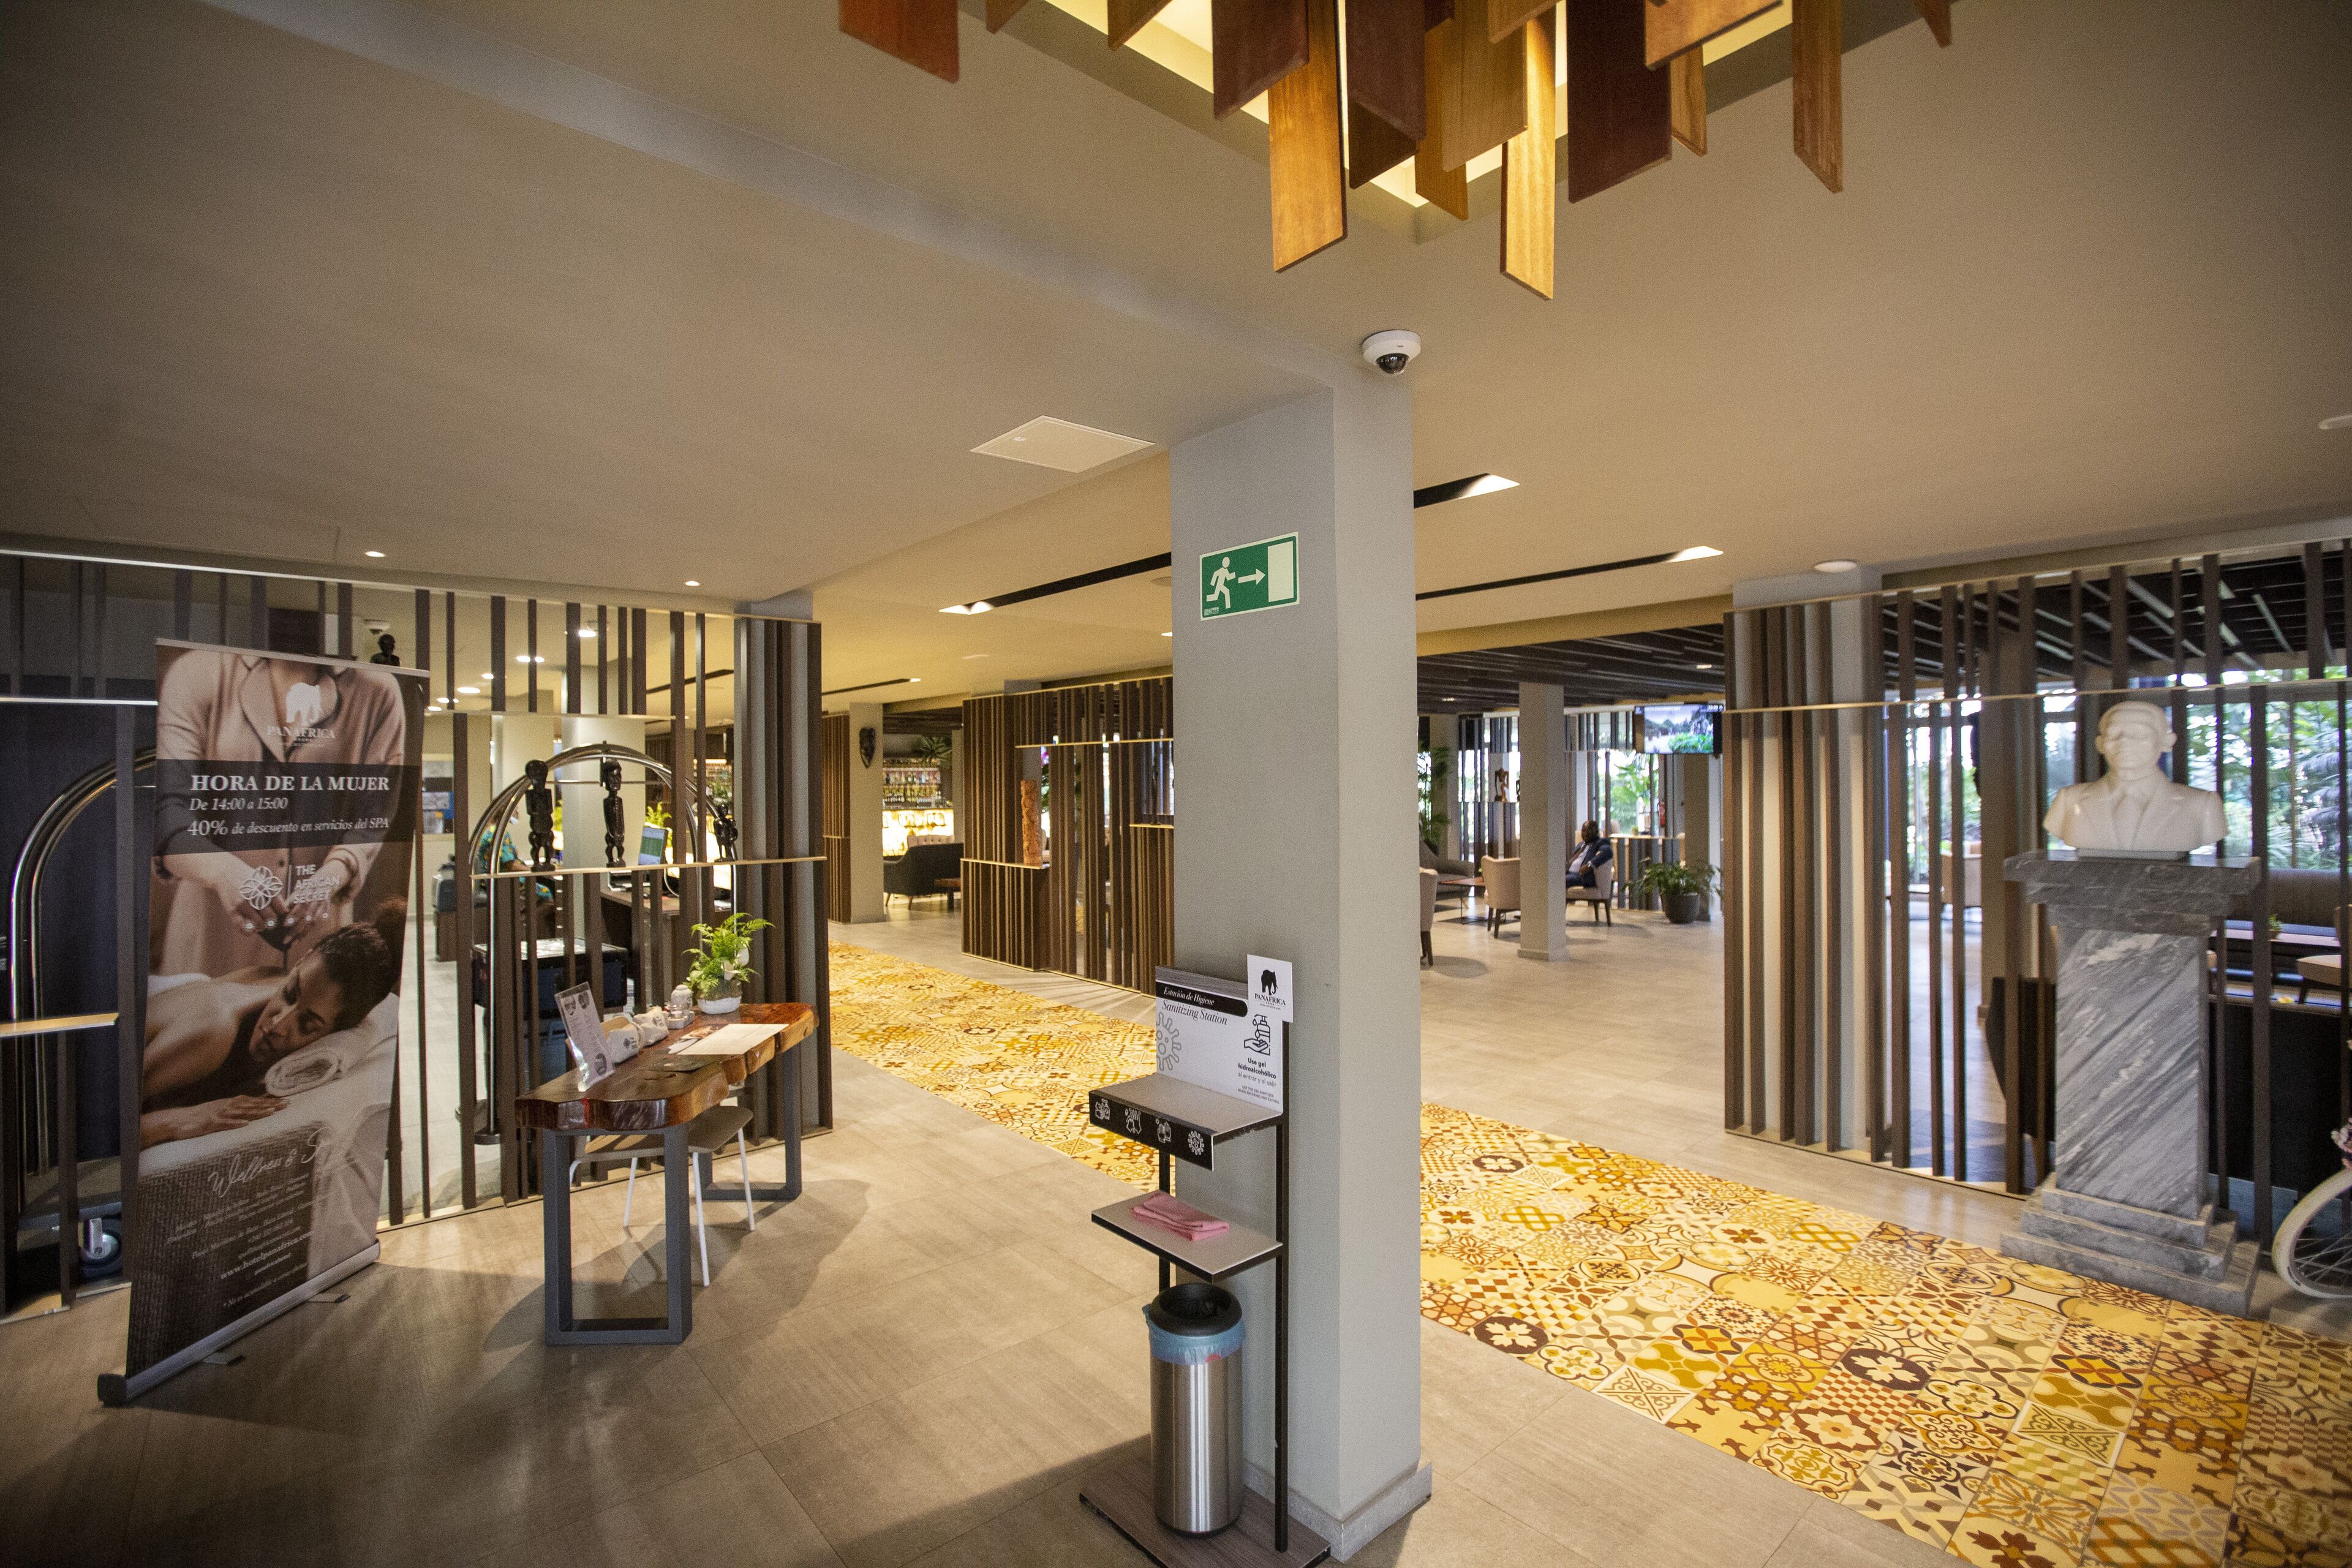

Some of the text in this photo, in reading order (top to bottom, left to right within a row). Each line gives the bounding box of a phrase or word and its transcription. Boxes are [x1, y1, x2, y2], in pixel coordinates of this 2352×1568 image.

[190, 775, 390, 791] HORA DE LA MUJER
[190, 797, 288, 811] De 14:00 a 15:00
[187, 817, 390, 836] 40% de descuento en servicios del SPA
[295, 864, 316, 876] THE
[1164, 987, 1215, 1006] Estación de Higiene
[1254, 993, 1286, 1006] PANAFRICA
[1162, 1000, 1227, 1025] Sanitizing Station
[1238, 1063, 1276, 1079] hidroalcohólico
[207, 1154, 283, 1197] Wellness
